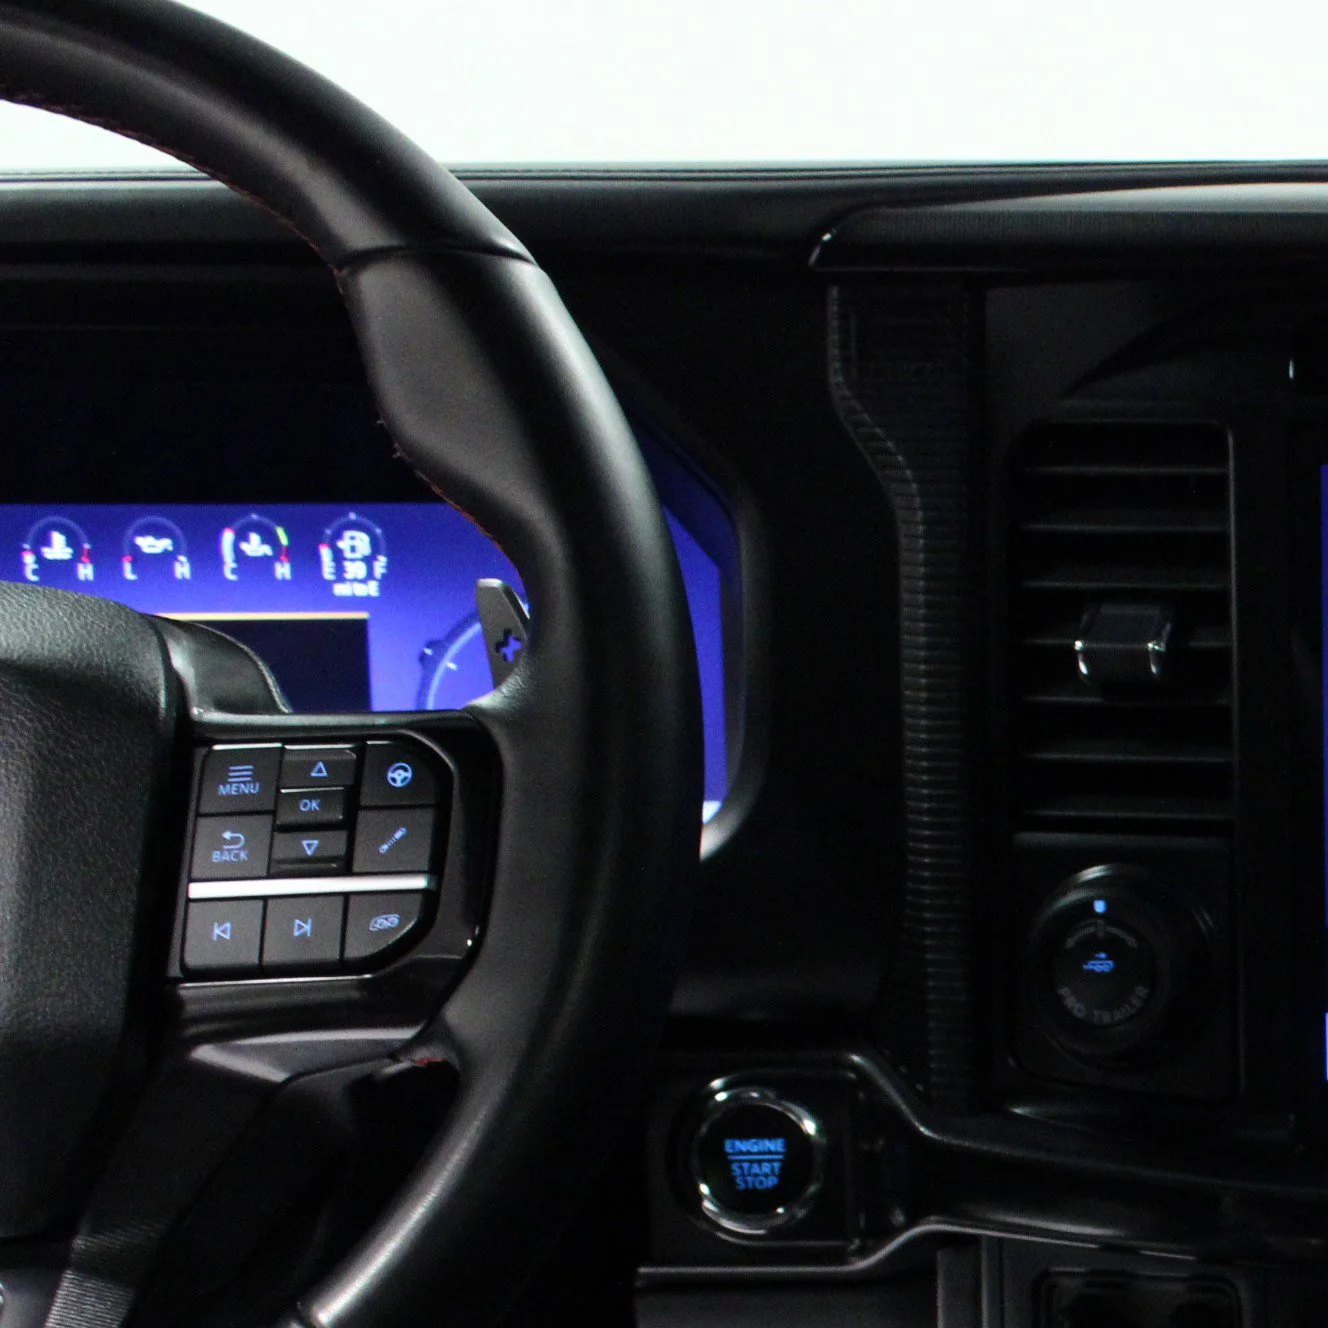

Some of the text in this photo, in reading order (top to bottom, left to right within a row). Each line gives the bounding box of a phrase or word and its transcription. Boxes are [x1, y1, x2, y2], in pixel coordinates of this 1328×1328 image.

[26, 564, 40, 582] C
[77, 563, 95, 581] H
[122, 562, 137, 580] L
[174, 561, 192, 580] H
[222, 562, 238, 580] C
[273, 562, 292, 580] H
[321, 560, 337, 581] E
[372, 558, 388, 580] F
[217, 783, 261, 797] MENU
[299, 798, 322, 812] OK
[211, 851, 249, 864] BACK
[723, 1138, 787, 1153] ENGINE
[730, 1161, 783, 1175] START
[734, 1175, 780, 1190] STOP
